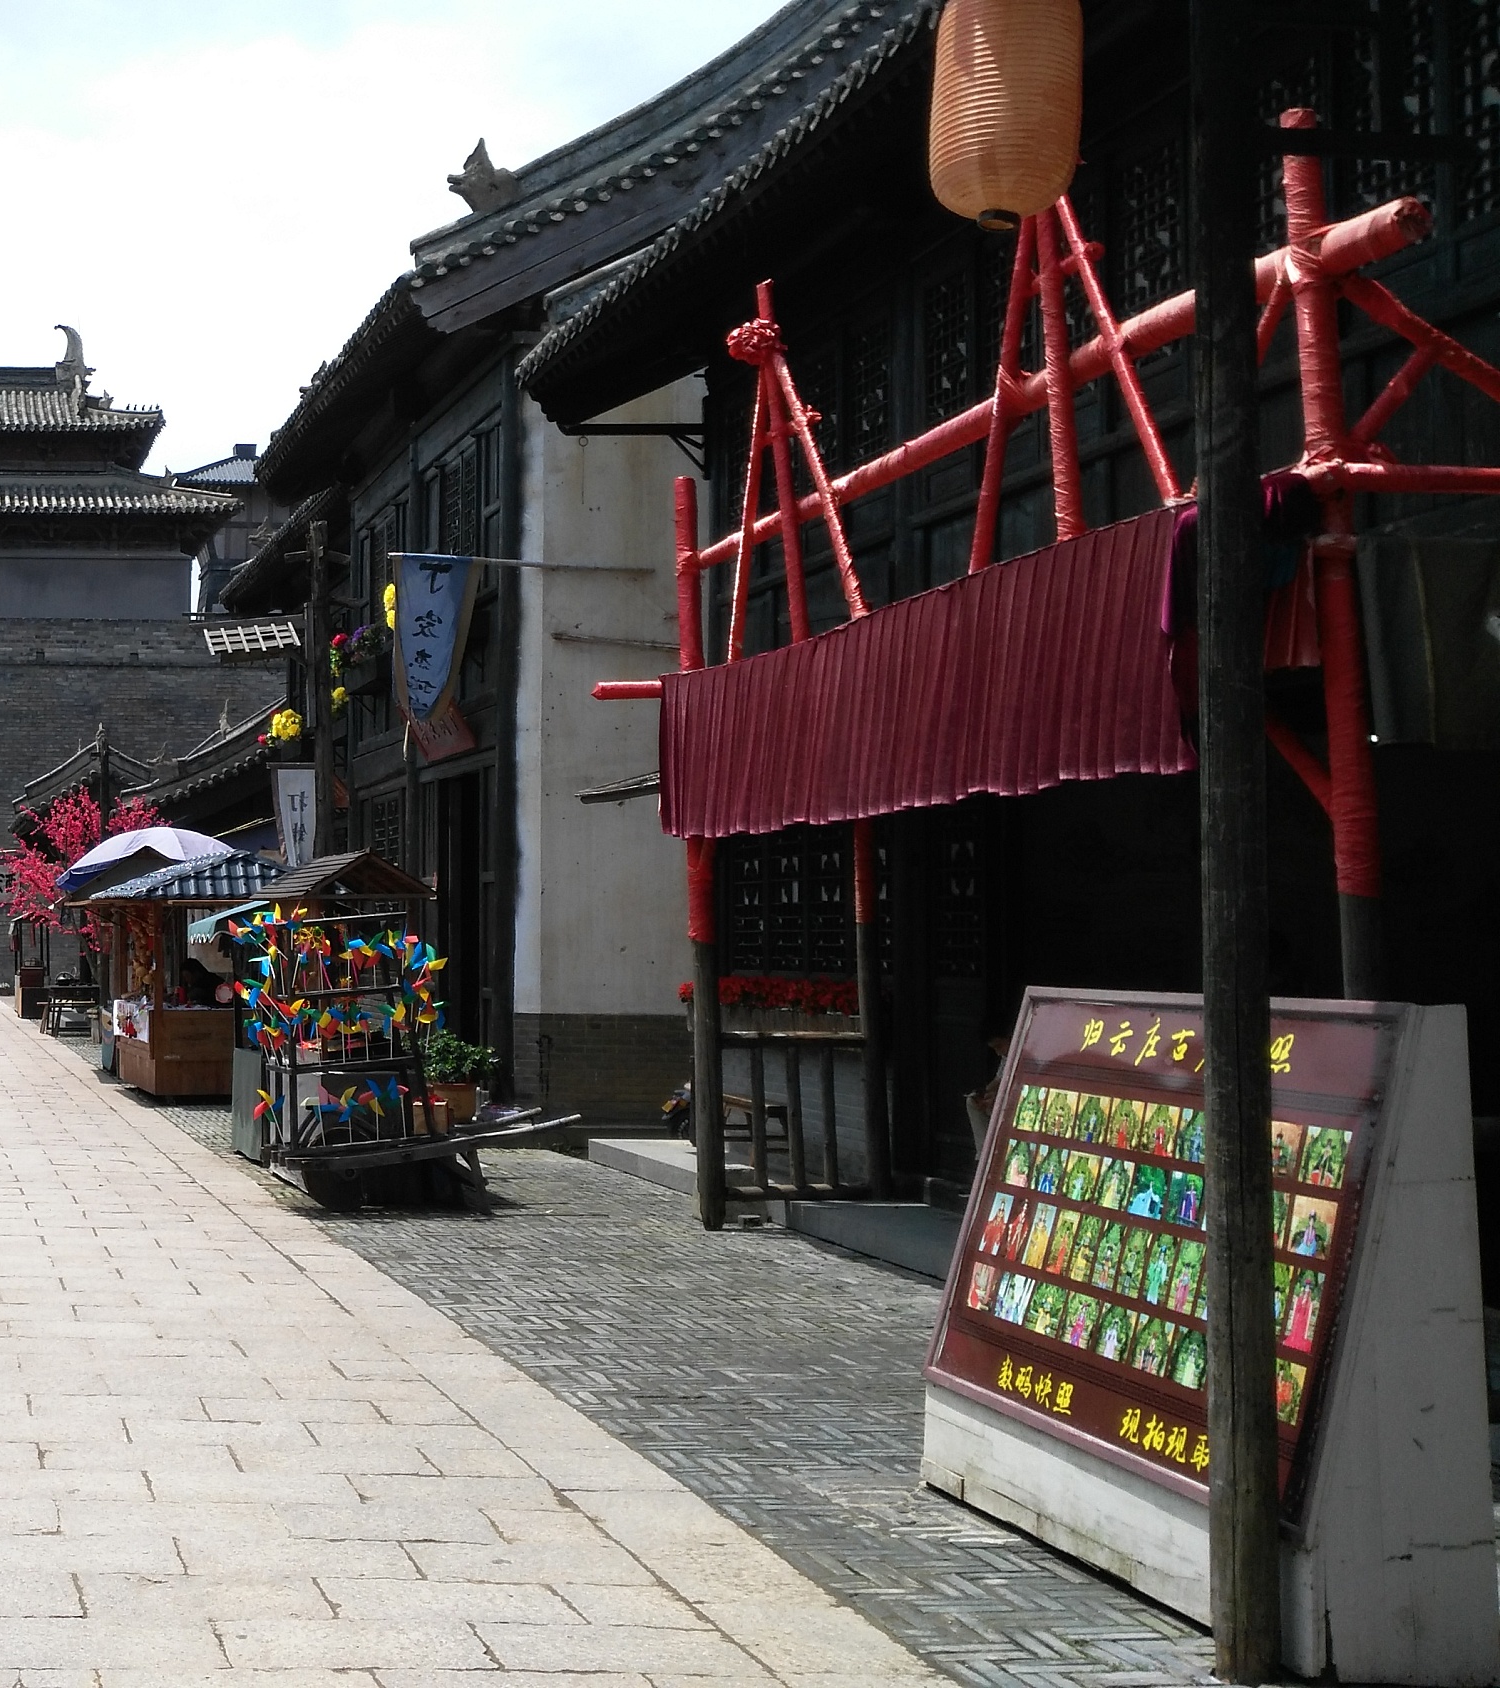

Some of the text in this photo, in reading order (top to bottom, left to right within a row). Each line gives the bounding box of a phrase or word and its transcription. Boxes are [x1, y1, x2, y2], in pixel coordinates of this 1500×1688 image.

[1080, 1017, 1295, 1074] 归云庄古照
[997, 1354, 1074, 1416] 数码快照
